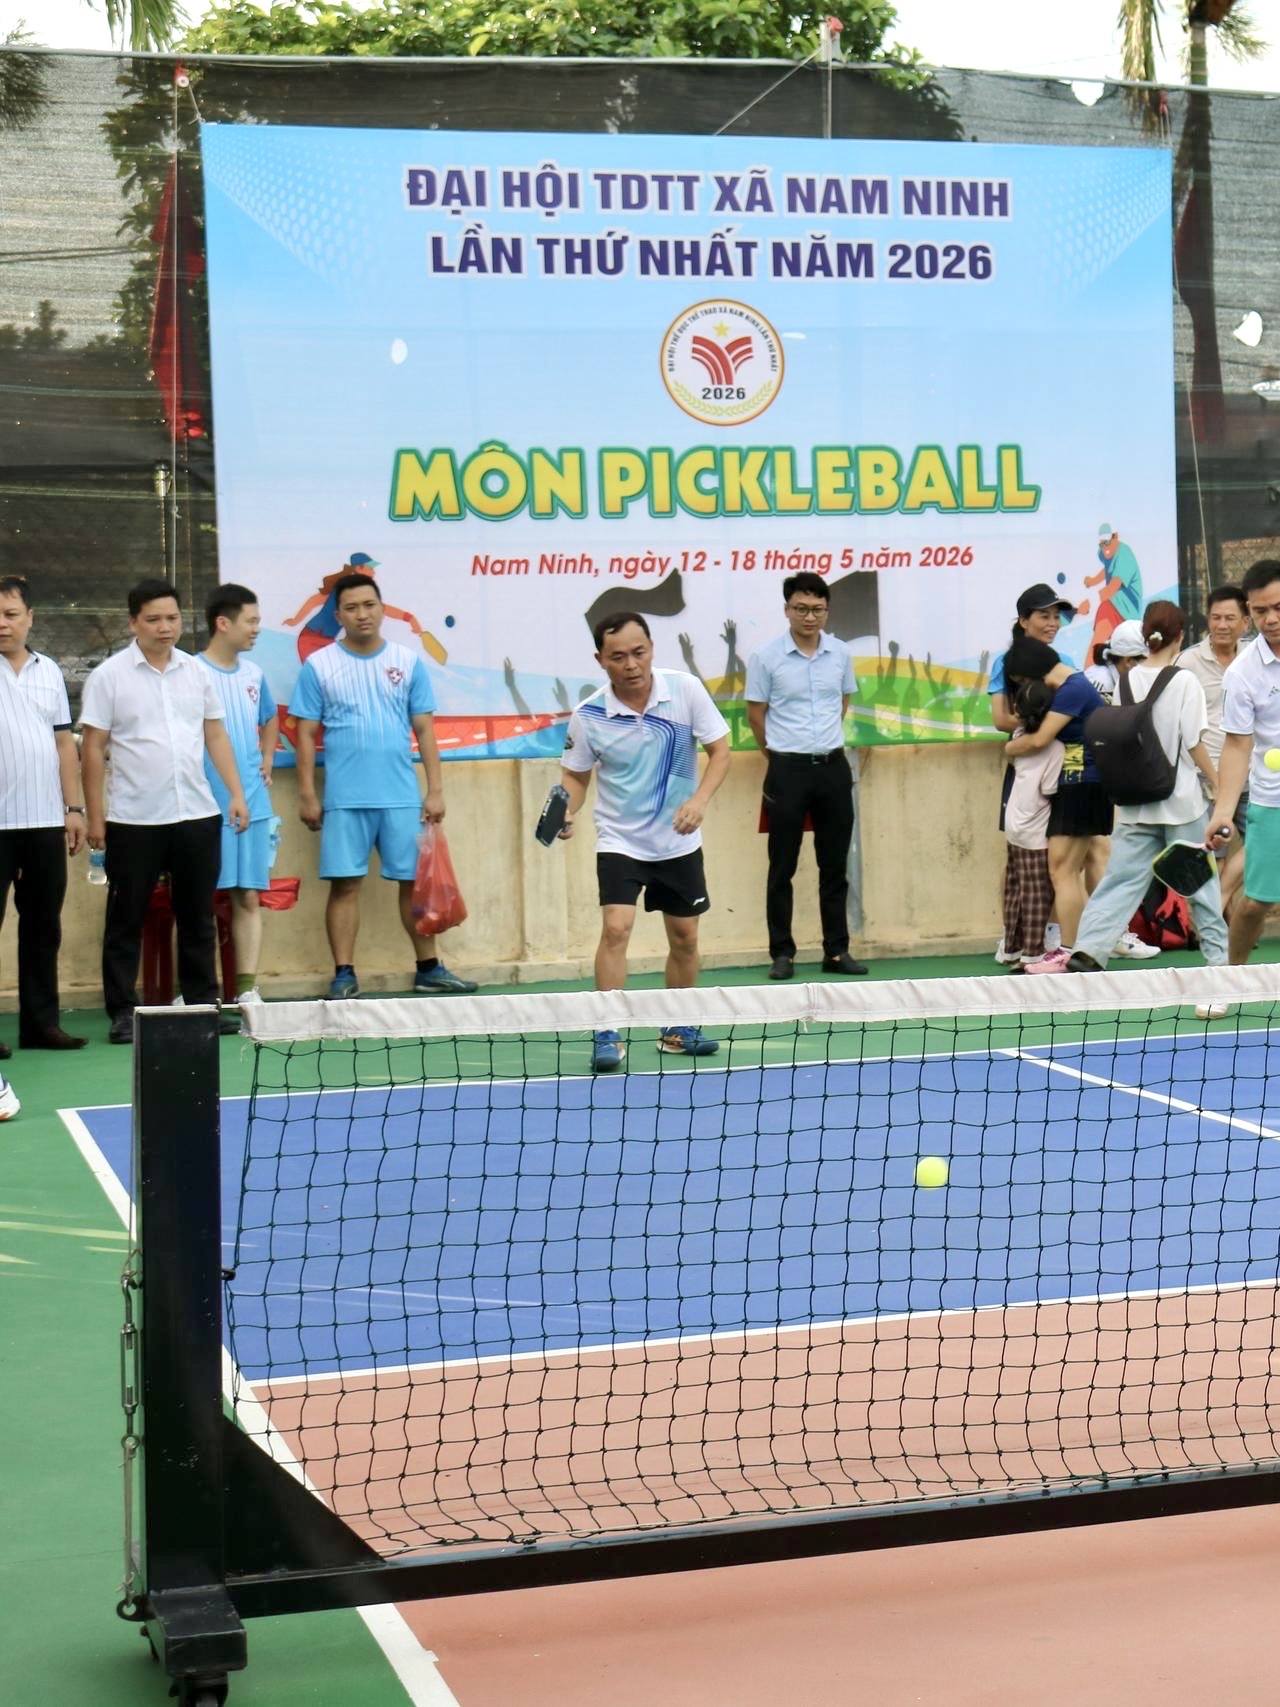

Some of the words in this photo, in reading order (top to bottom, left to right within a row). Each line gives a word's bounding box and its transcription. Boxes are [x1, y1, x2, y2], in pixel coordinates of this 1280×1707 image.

[407, 168, 487, 216] ĐẠI
[503, 163, 580, 217] HỘI
[594, 173, 700, 211] TDTT
[714, 168, 774, 212] XÃ
[787, 178, 889, 215] NAM
[903, 180, 1009, 217] NINH
[432, 223, 523, 273] LẦN
[537, 231, 629, 275] THỨ
[639, 228, 758, 276] NHẤT
[772, 234, 874, 278] NĂM
[888, 244, 992, 280] 2026
[702, 387, 746, 400] 2026
[389, 440, 588, 521] MÔN
[598, 444, 1042, 519] PICKLEBALL
[471, 554, 530, 576] Nam
[538, 553, 600, 578] Ninh,
[609, 551, 671, 580] ngày
[681, 551, 707, 572] 12
[729, 550, 757, 571] 18
[764, 547, 832, 576] tháng
[840, 548, 854, 569] 5
[861, 546, 912, 569] năm
[919, 546, 974, 567] 2026
